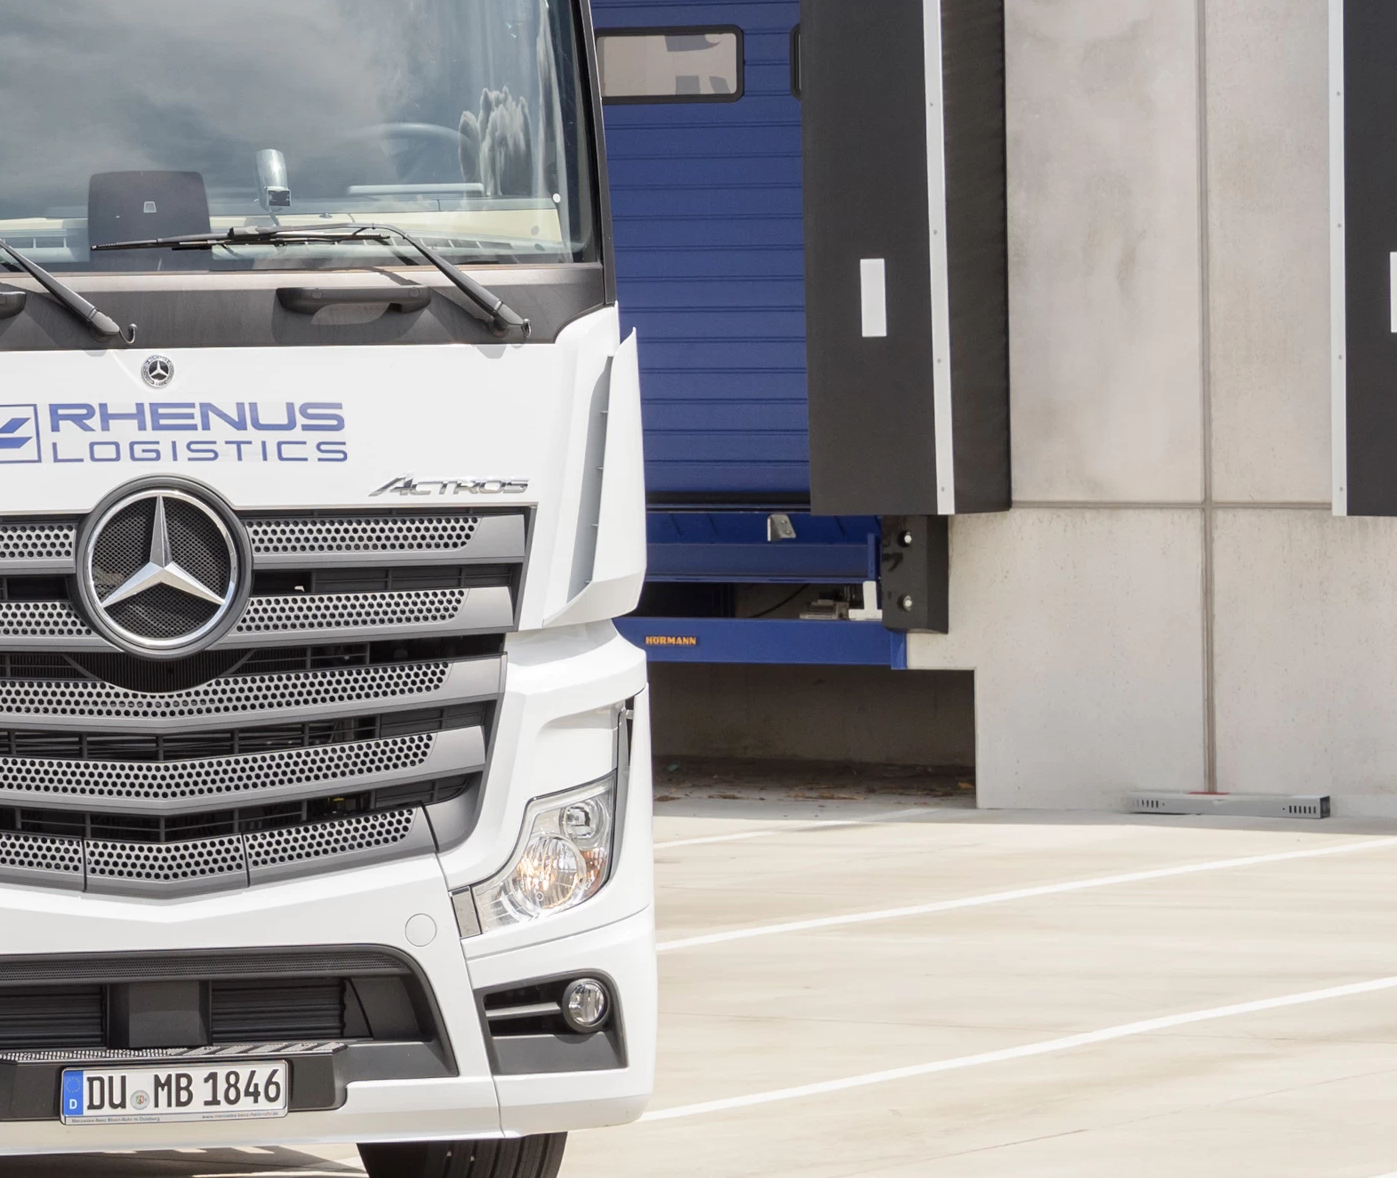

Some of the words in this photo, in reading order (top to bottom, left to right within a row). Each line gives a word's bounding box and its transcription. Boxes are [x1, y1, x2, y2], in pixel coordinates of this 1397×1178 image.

[48, 401, 346, 434] RHENUS
[51, 439, 349, 465] LOGISTICS
[367, 473, 530, 497] ACTROS
[86, 1075, 127, 1110] DU
[153, 1072, 194, 1108] MB
[203, 1069, 281, 1106] 1846
[69, 1099, 78, 1110] D
